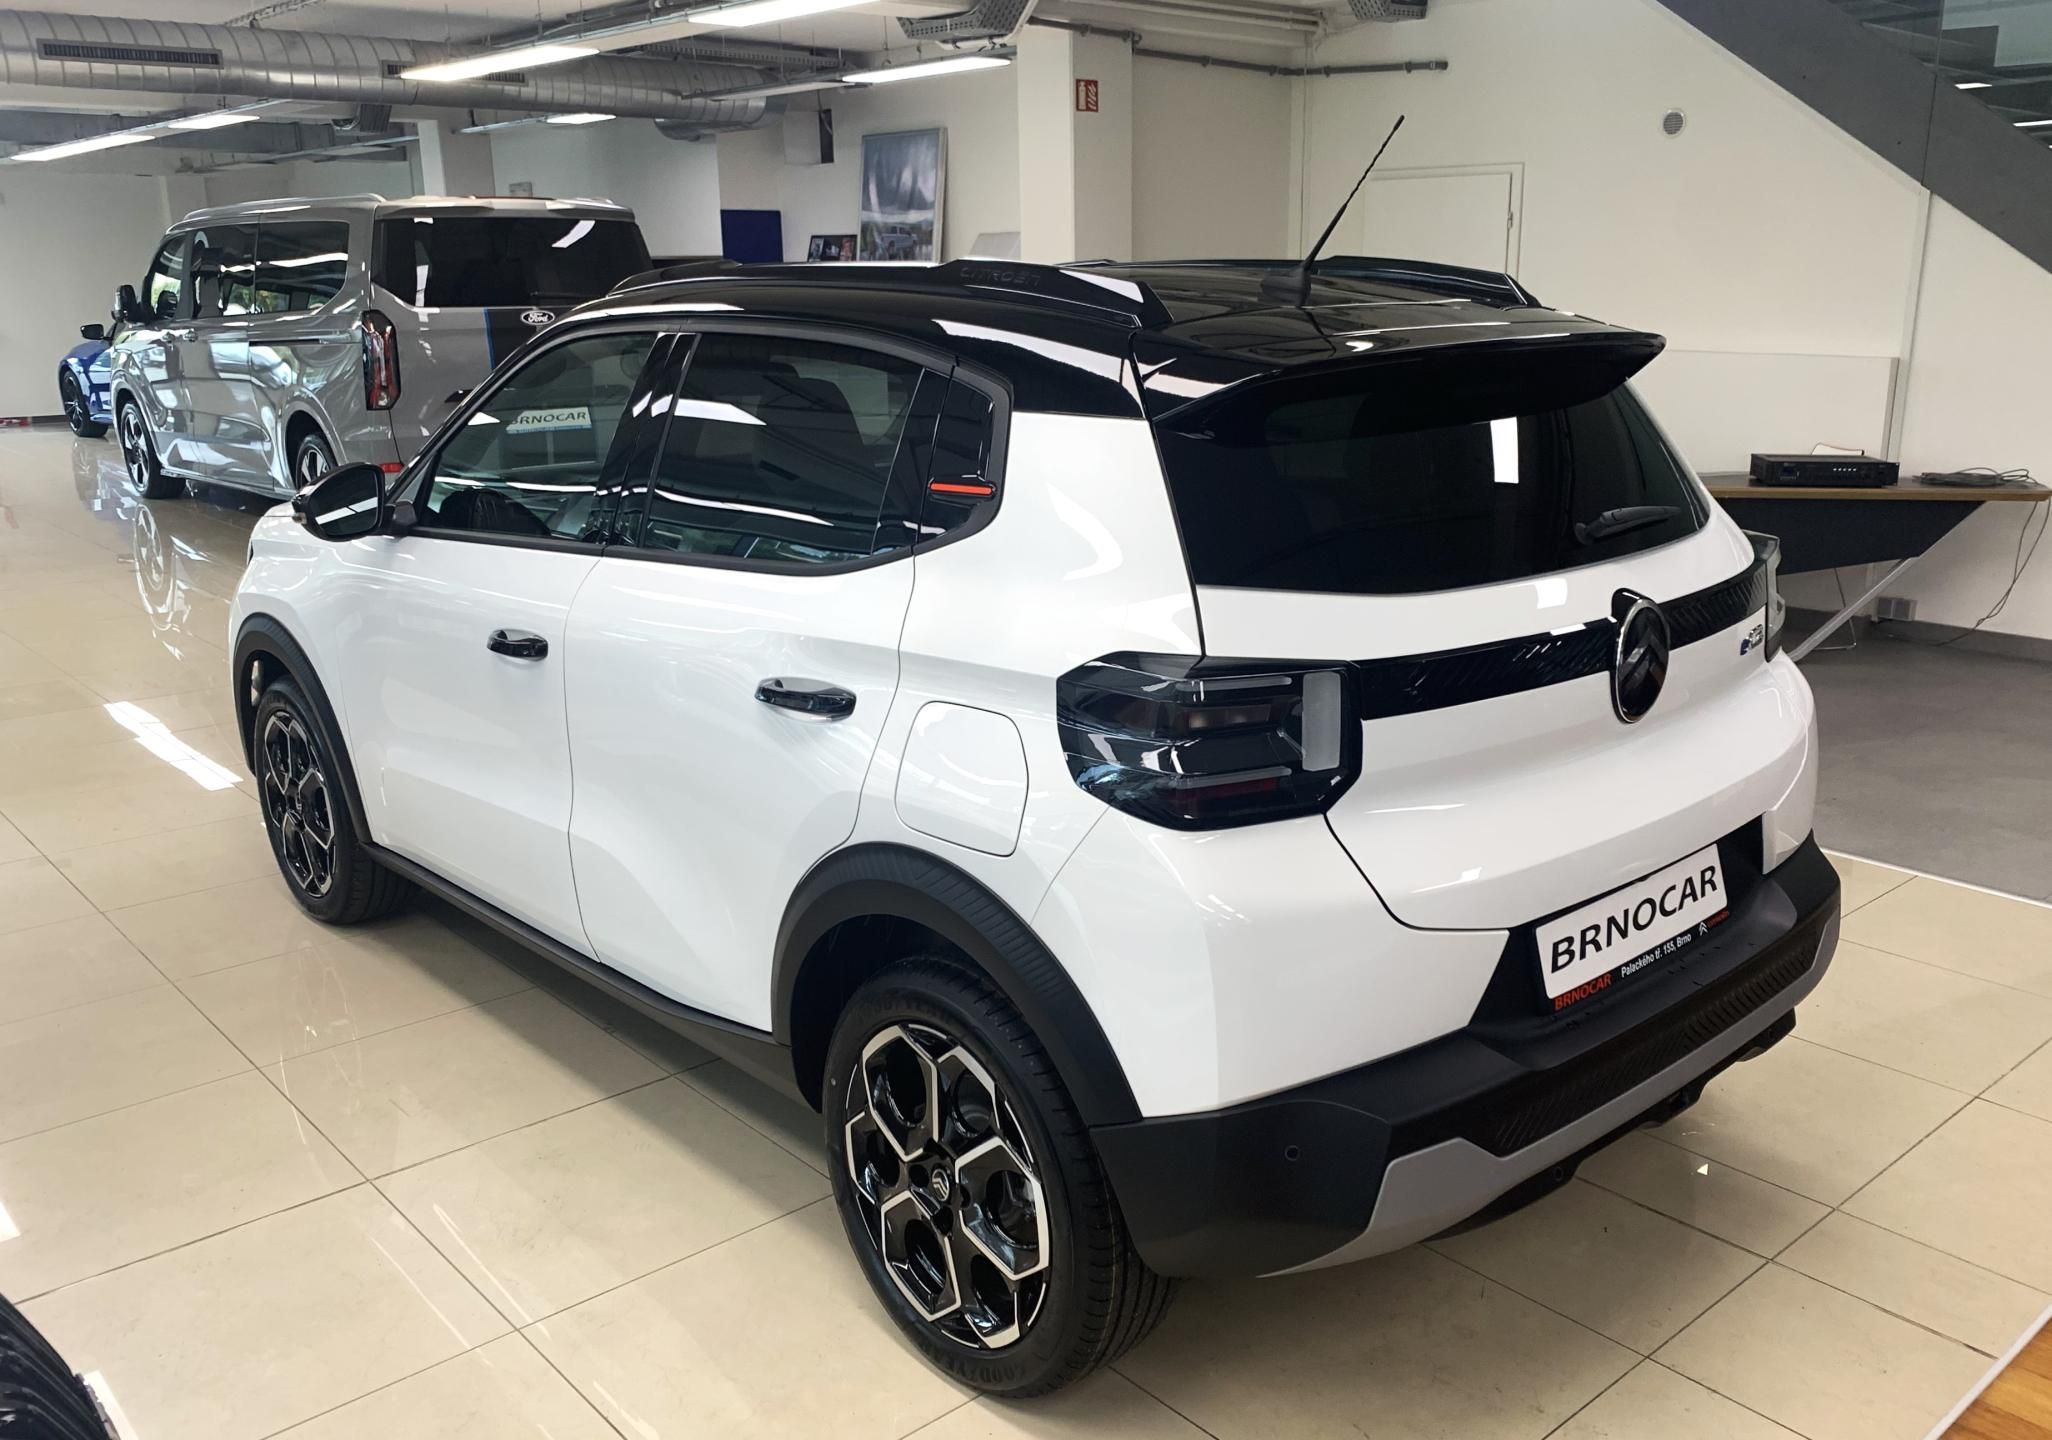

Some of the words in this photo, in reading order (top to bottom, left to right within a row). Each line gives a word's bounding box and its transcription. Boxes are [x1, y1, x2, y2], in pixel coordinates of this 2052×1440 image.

[1551, 865, 1718, 974] BRNOCAR
[1554, 973, 1612, 1011] BRNOCAR
[1621, 953, 1655, 978] Palackého
[1676, 934, 1692, 947] Brno
